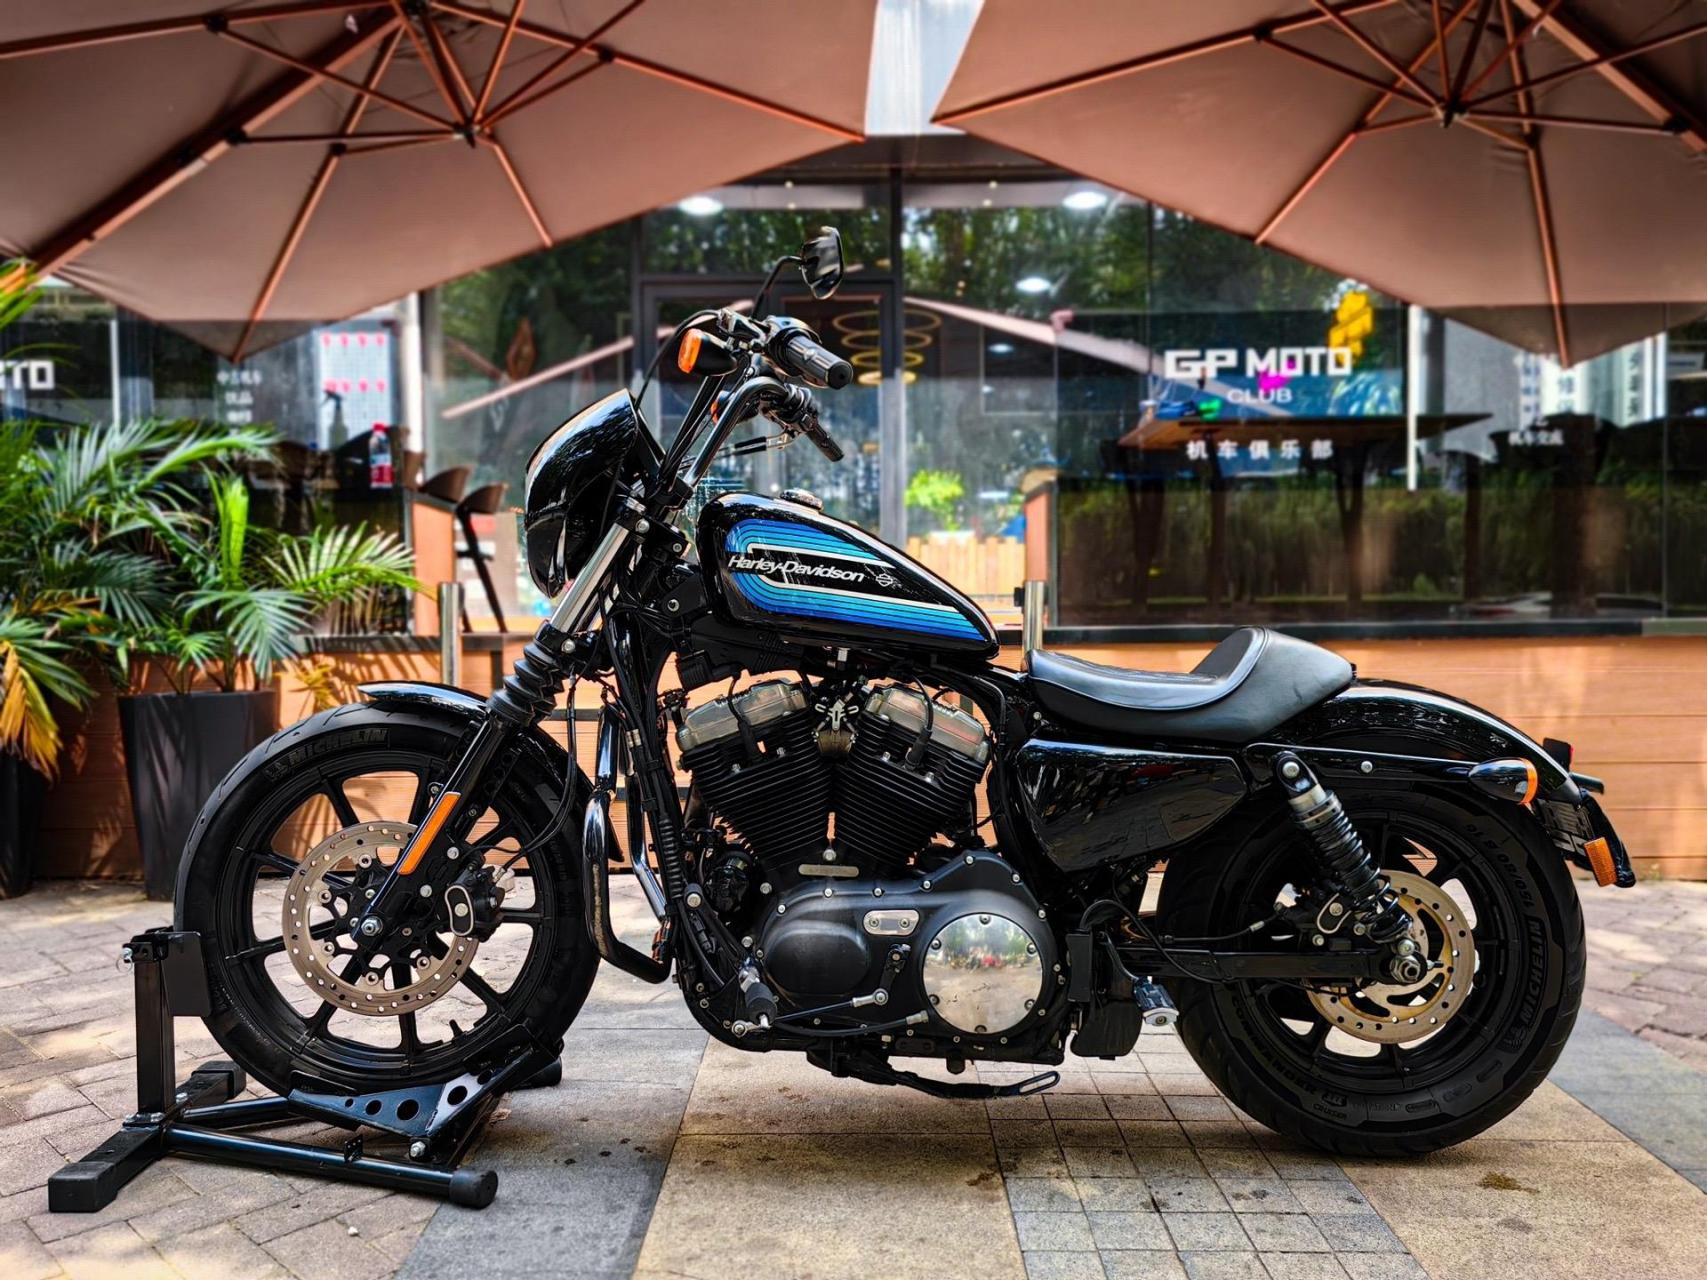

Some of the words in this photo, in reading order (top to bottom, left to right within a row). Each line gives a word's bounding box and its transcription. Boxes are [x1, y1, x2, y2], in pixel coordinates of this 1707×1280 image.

[0, 360, 54, 389] TO
[1164, 349, 1237, 378] GP
[1246, 347, 1352, 377] MOTO
[1227, 386, 1292, 403] CLUB
[1187, 439, 1333, 460] 机车俱乐部
[728, 555, 864, 583] Harley-Davidson
[1519, 919, 1545, 1024] MICHELIN
